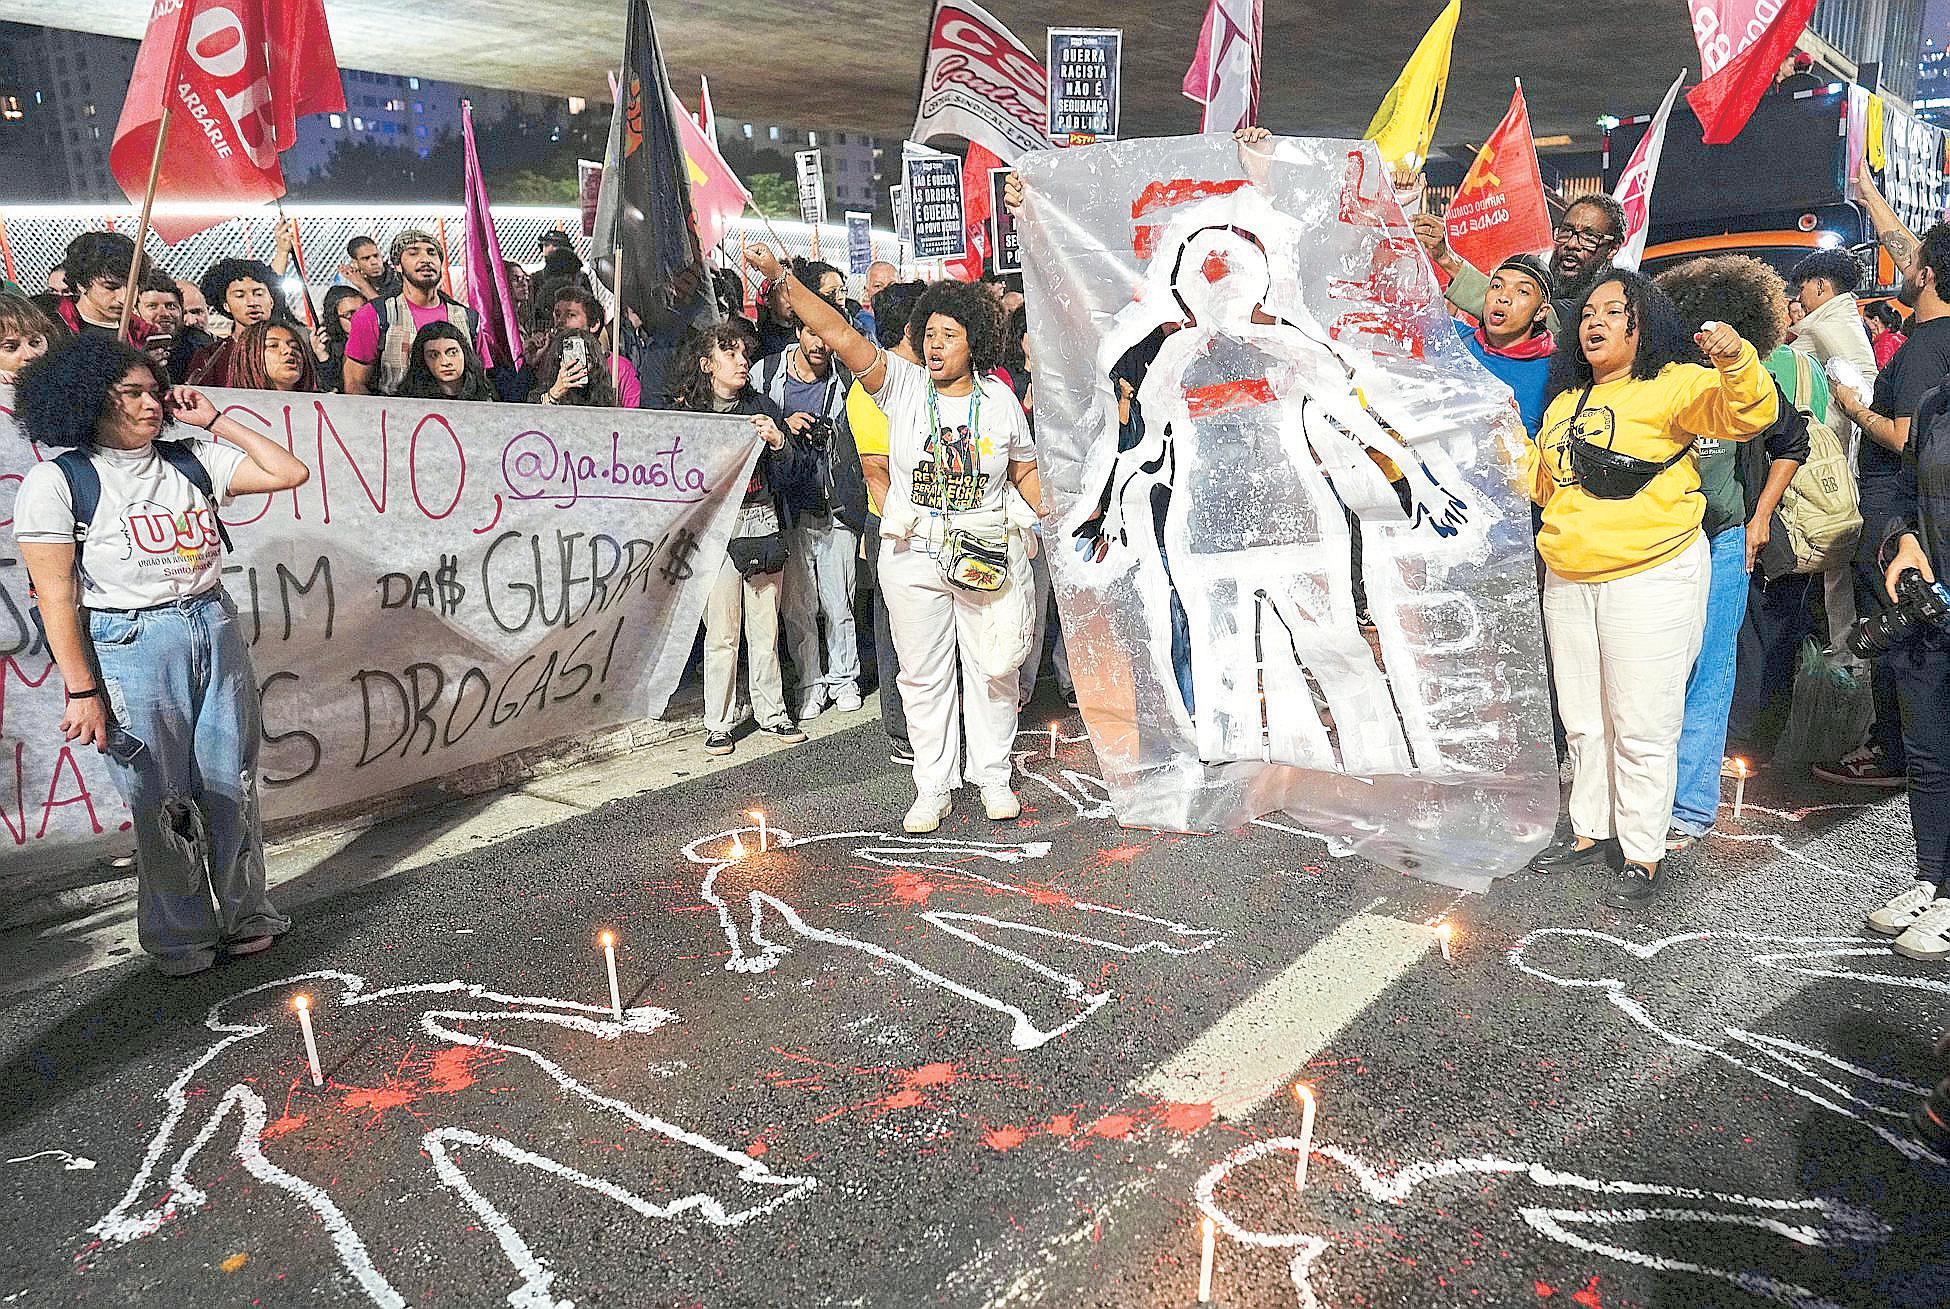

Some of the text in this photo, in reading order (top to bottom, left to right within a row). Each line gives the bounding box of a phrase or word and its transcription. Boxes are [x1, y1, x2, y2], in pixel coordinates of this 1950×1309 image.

[1062, 48, 1105, 63] GUERRA
[1060, 64, 1107, 78] RACISTA
[1065, 80, 1102, 96] NÃO É
[1058, 99, 1109, 113] SEGURANÇA
[178, 74, 233, 159] ARBÁRIE
[1058, 114, 1108, 129] PÚBLICA
[923, 203, 960, 221] GUERRA
[129, 509, 221, 553] UJS
[163, 567, 193, 577] Santo
[351, 615, 625, 768] DROGAS!
